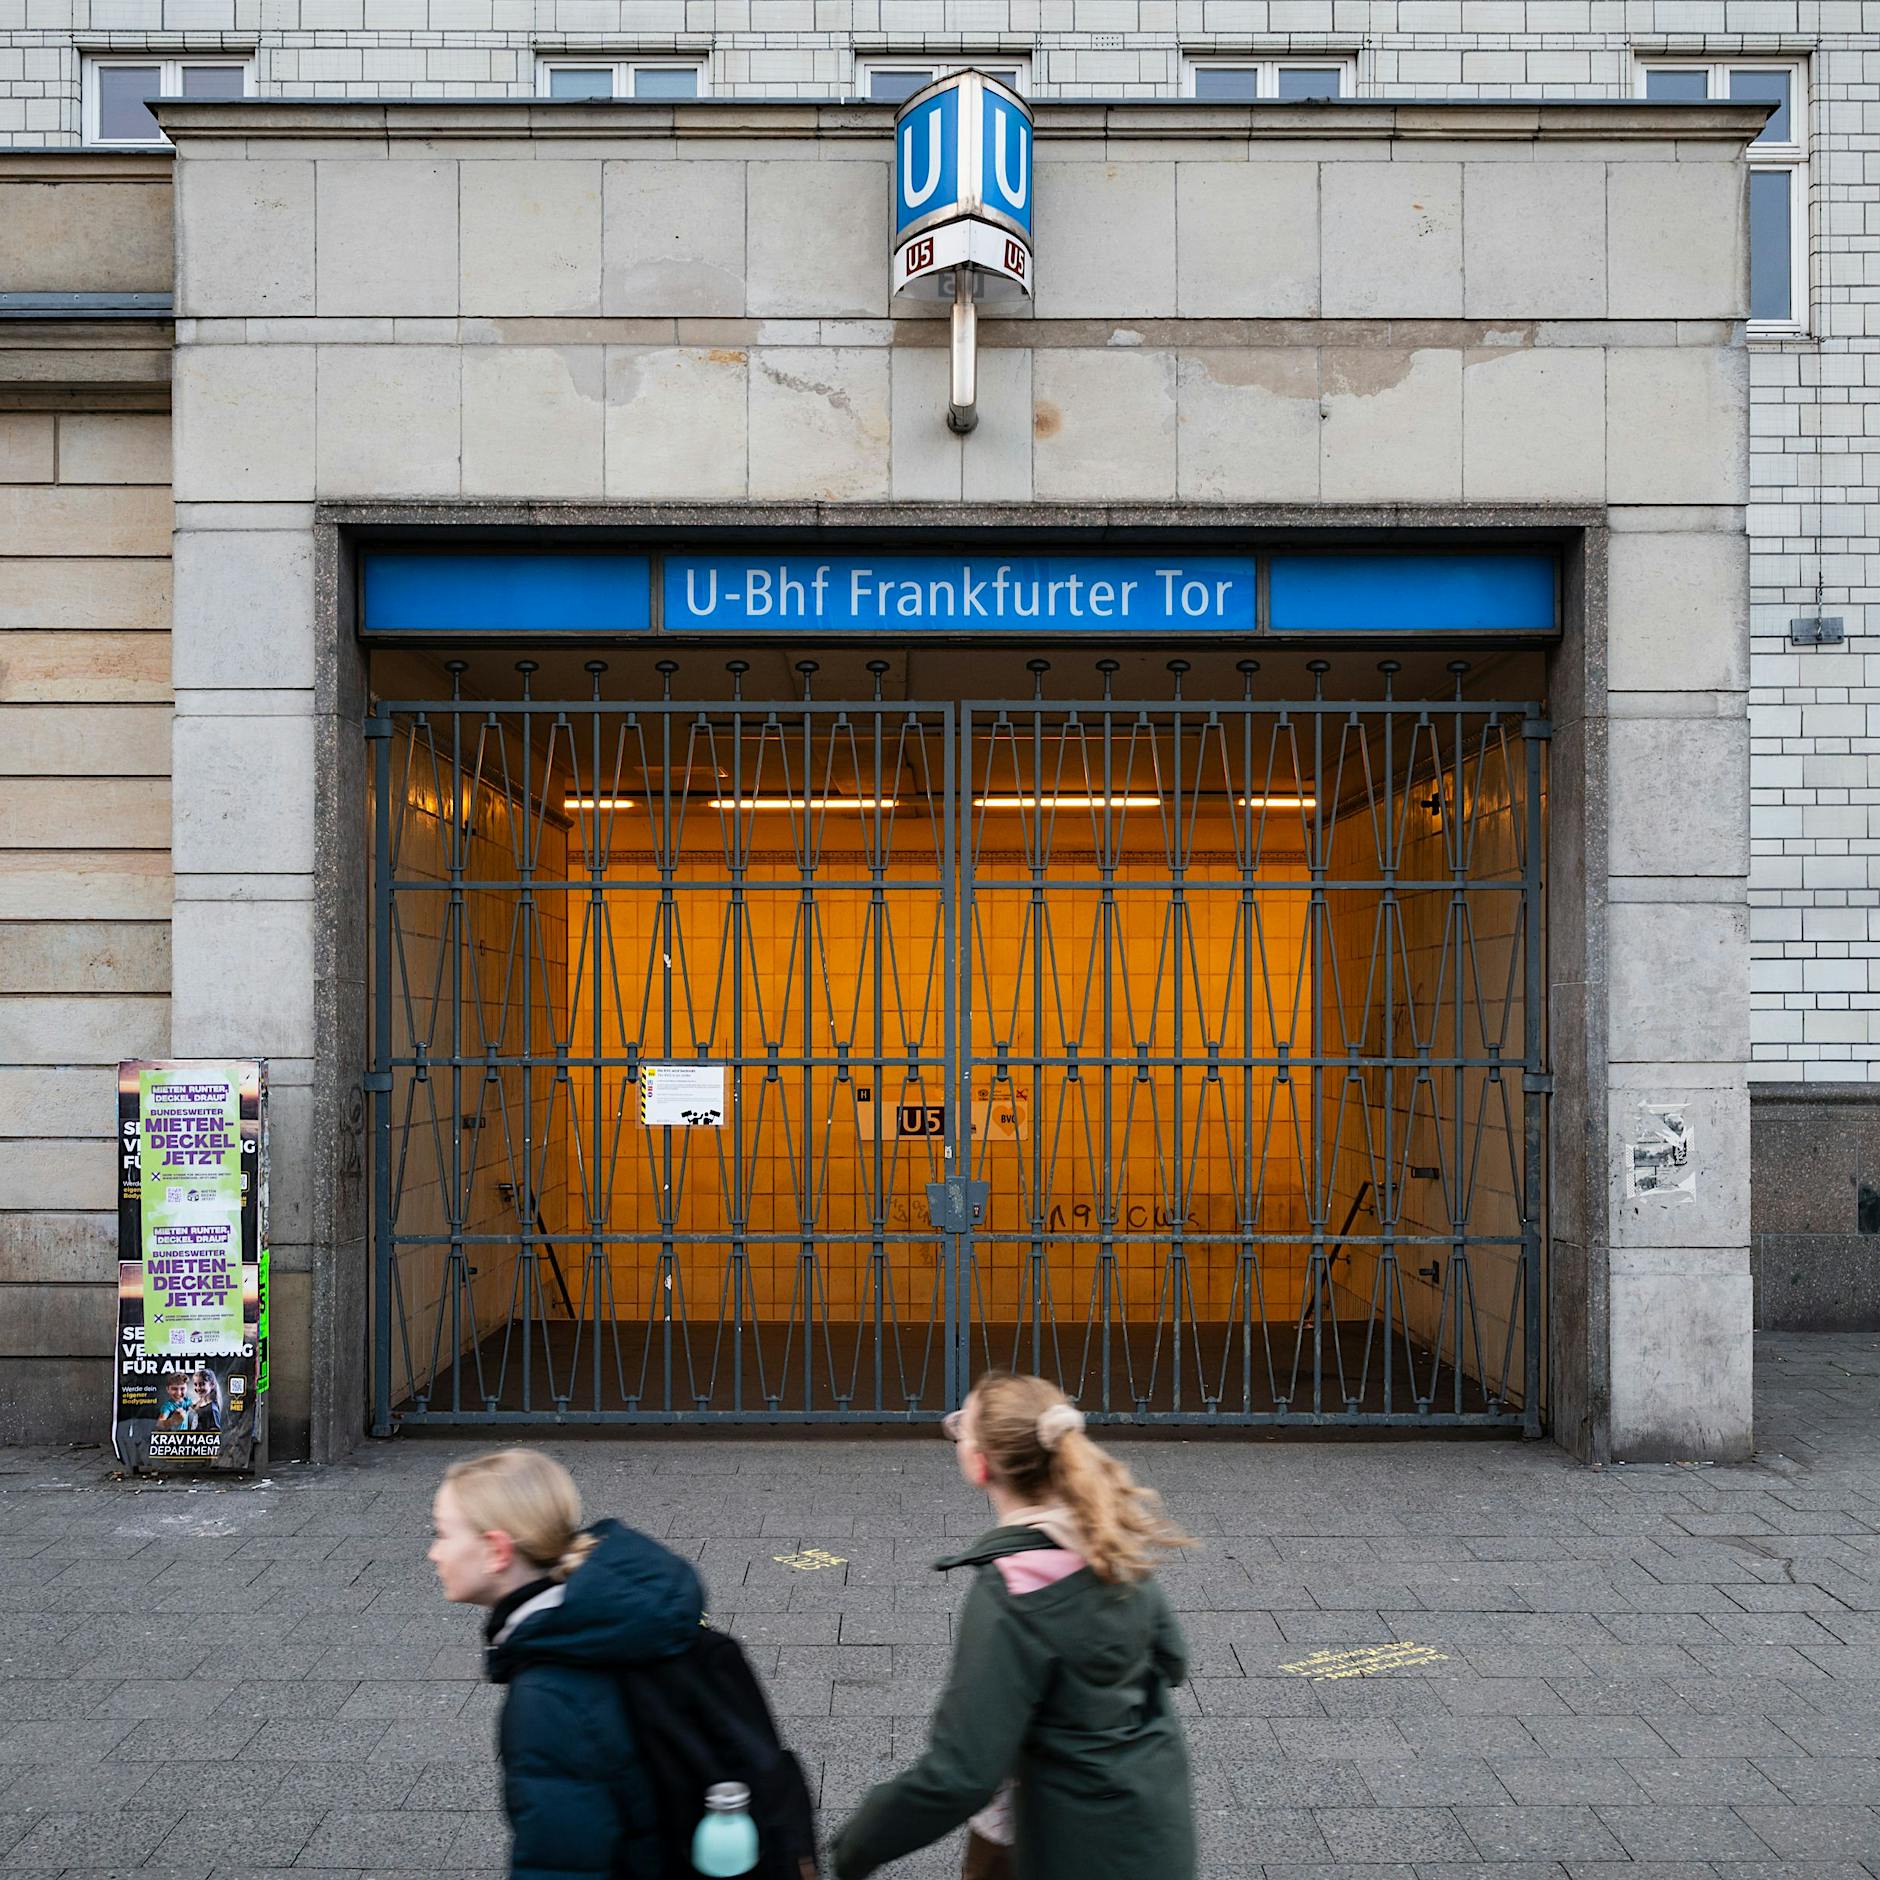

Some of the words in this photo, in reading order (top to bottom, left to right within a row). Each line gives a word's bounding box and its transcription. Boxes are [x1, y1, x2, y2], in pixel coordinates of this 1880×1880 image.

[903, 108, 942, 209] U
[994, 108, 1027, 210] U
[908, 240, 931, 271] U5
[1008, 243, 1024, 275] U5
[687, 566, 829, 615] U-Bhf
[851, 566, 1137, 615] Frankfurter
[1155, 569, 1232, 615] Tor
[156, 1094, 191, 1102] DECKEL
[194, 1093, 226, 1102] DRAUF
[150, 1108, 225, 1116] BUNDESWEITER
[145, 1117, 234, 1133] MIETEN-
[902, 1109, 941, 1133] U5
[151, 1133, 236, 1149] DECKEL
[162, 1150, 226, 1166] JETZT
[154, 1227, 188, 1235] MIETEN
[157, 1236, 194, 1244] DECKEL
[196, 1235, 228, 1243] DRAUF
[152, 1249, 226, 1258] BUNDESWEITER
[147, 1258, 236, 1275] MIETEN-
[153, 1274, 238, 1291] DECKEL
[165, 1291, 228, 1308] JETZT
[122, 1356, 157, 1374] FÜR
[160, 1360, 207, 1374] ALLE
[121, 1385, 143, 1393] Werde
[121, 1391, 147, 1399] eigener
[121, 1397, 158, 1405] Bodyguard
[150, 1434, 185, 1445] KRAV
[187, 1433, 220, 1444] MAGA
[149, 1445, 219, 1456] DEPARTMENT
